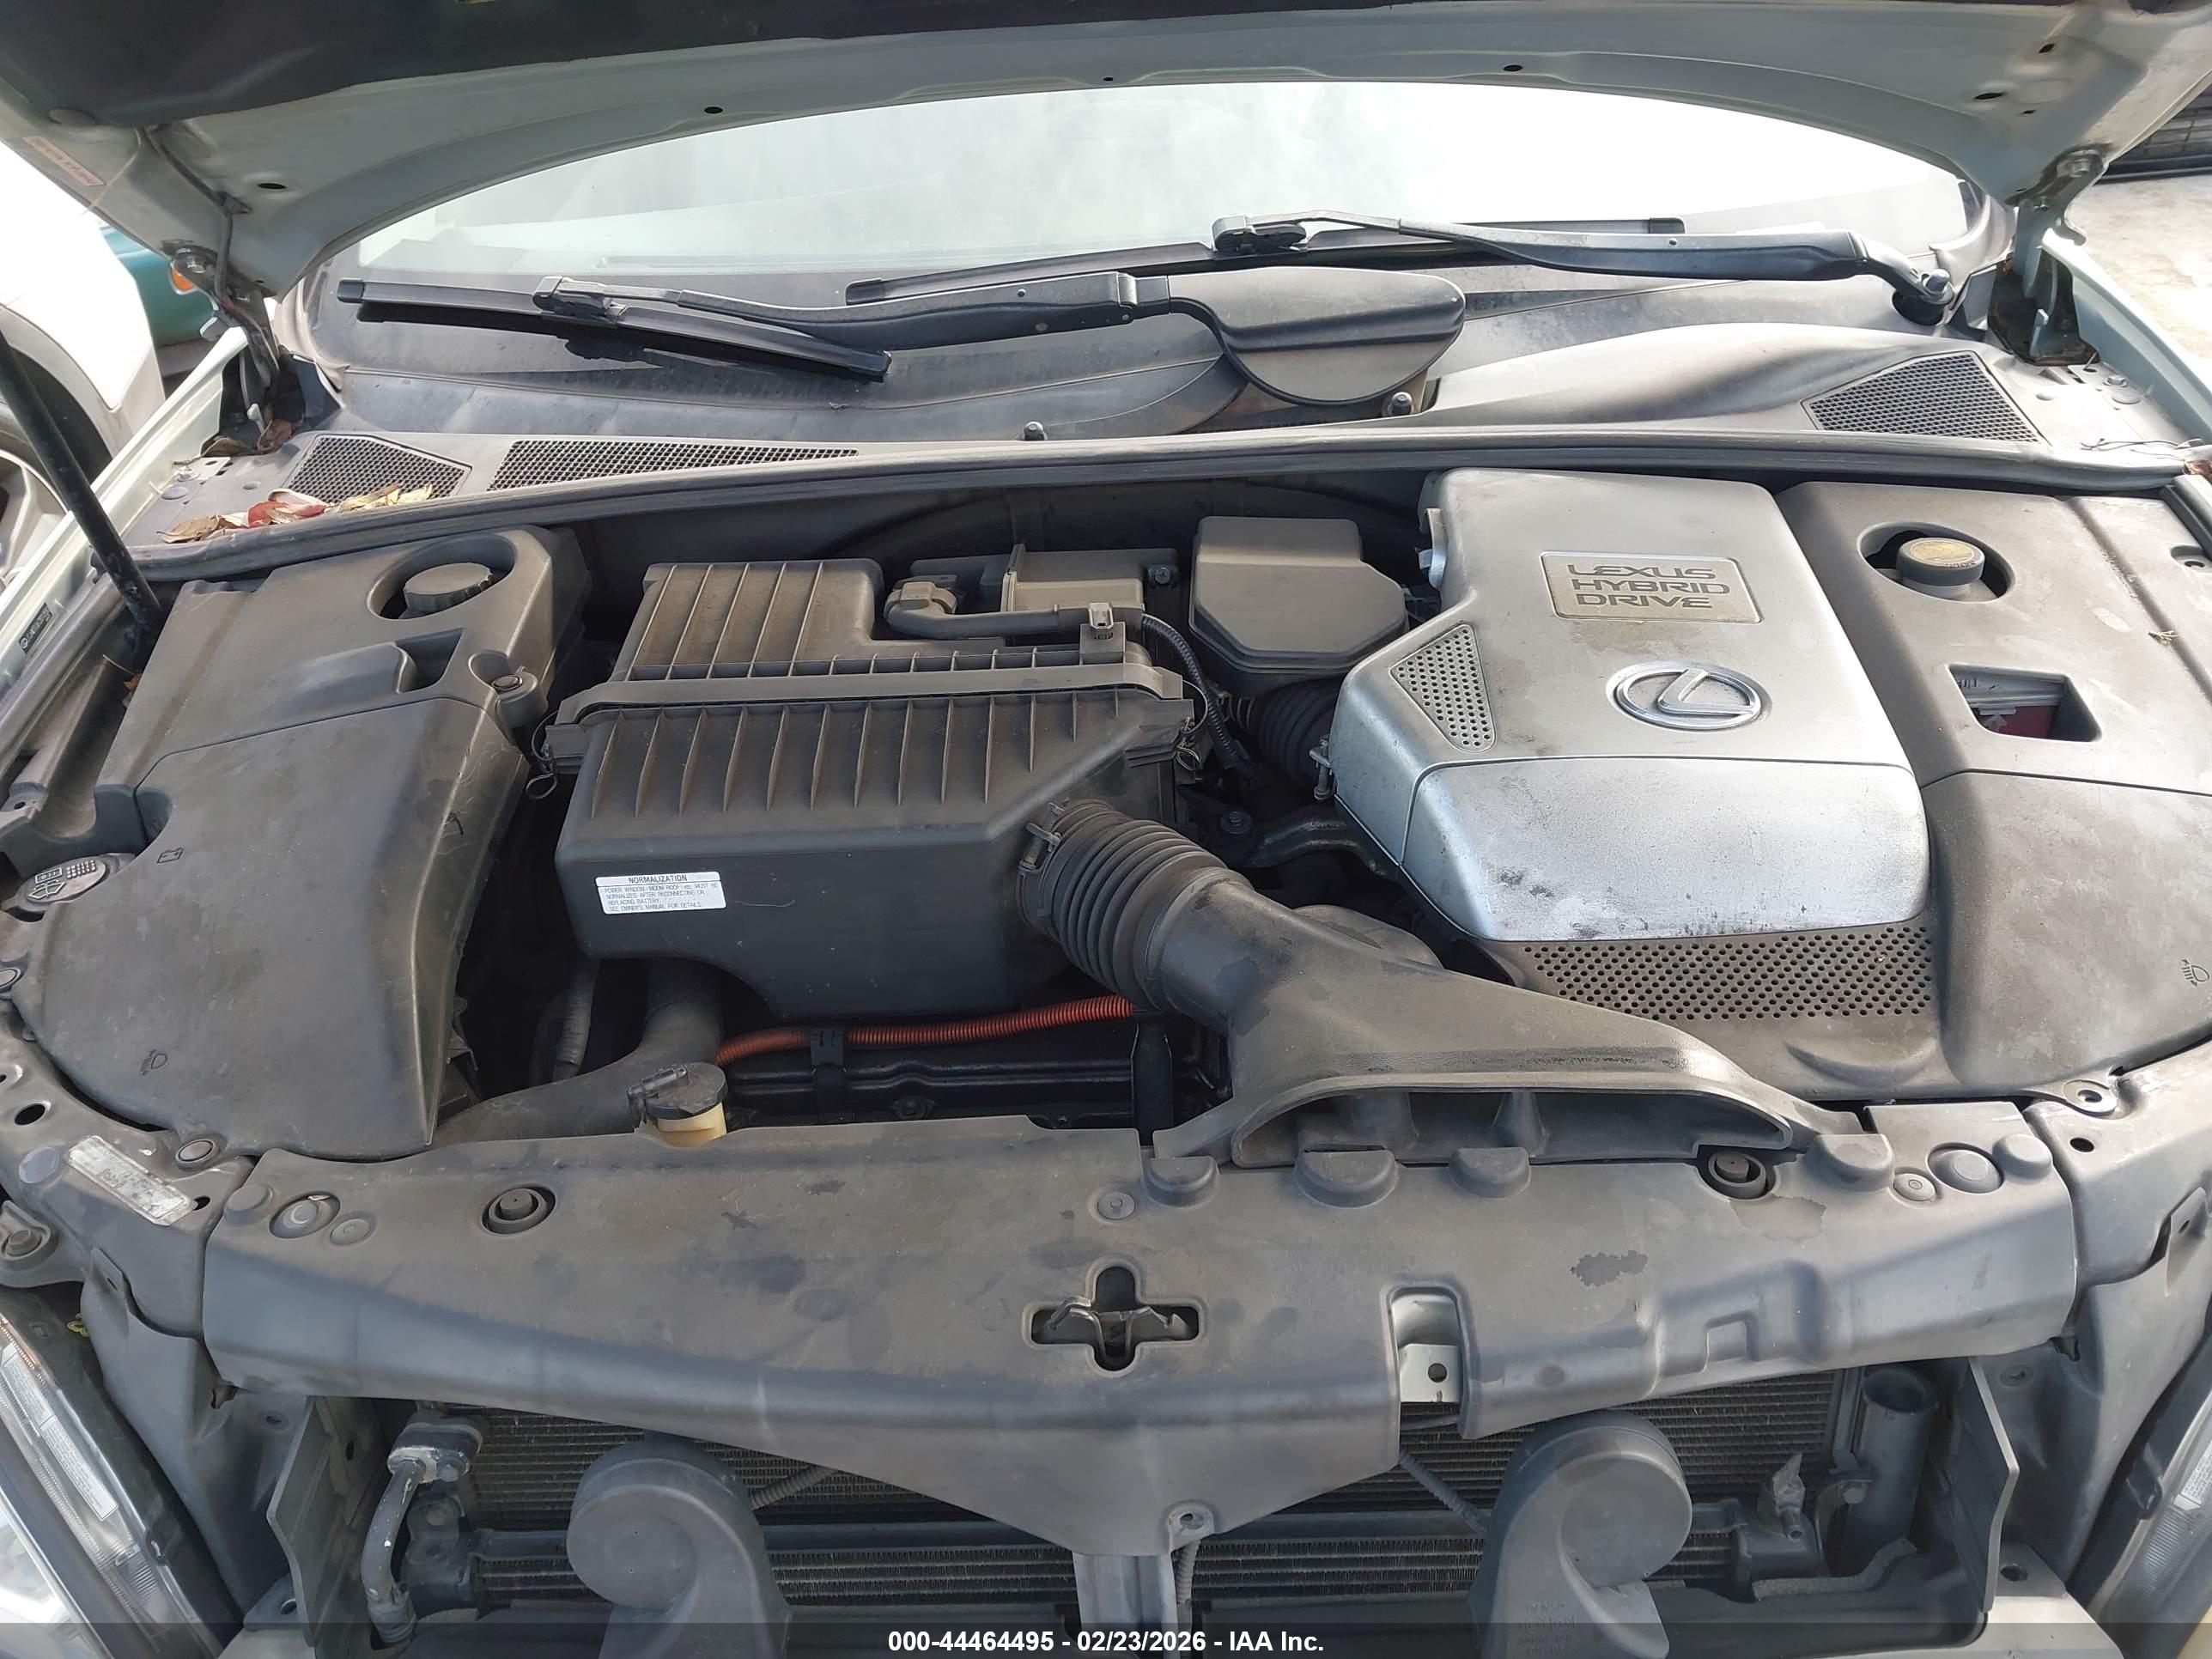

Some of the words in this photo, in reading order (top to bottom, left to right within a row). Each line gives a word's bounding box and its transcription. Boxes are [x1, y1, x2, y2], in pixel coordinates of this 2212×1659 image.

[1567, 564, 1717, 580] LEXUS
[1571, 579, 1730, 594] HYBRID
[1576, 593, 1713, 609] DRIVE
[628, 873, 688, 884] NORMALIZATION
